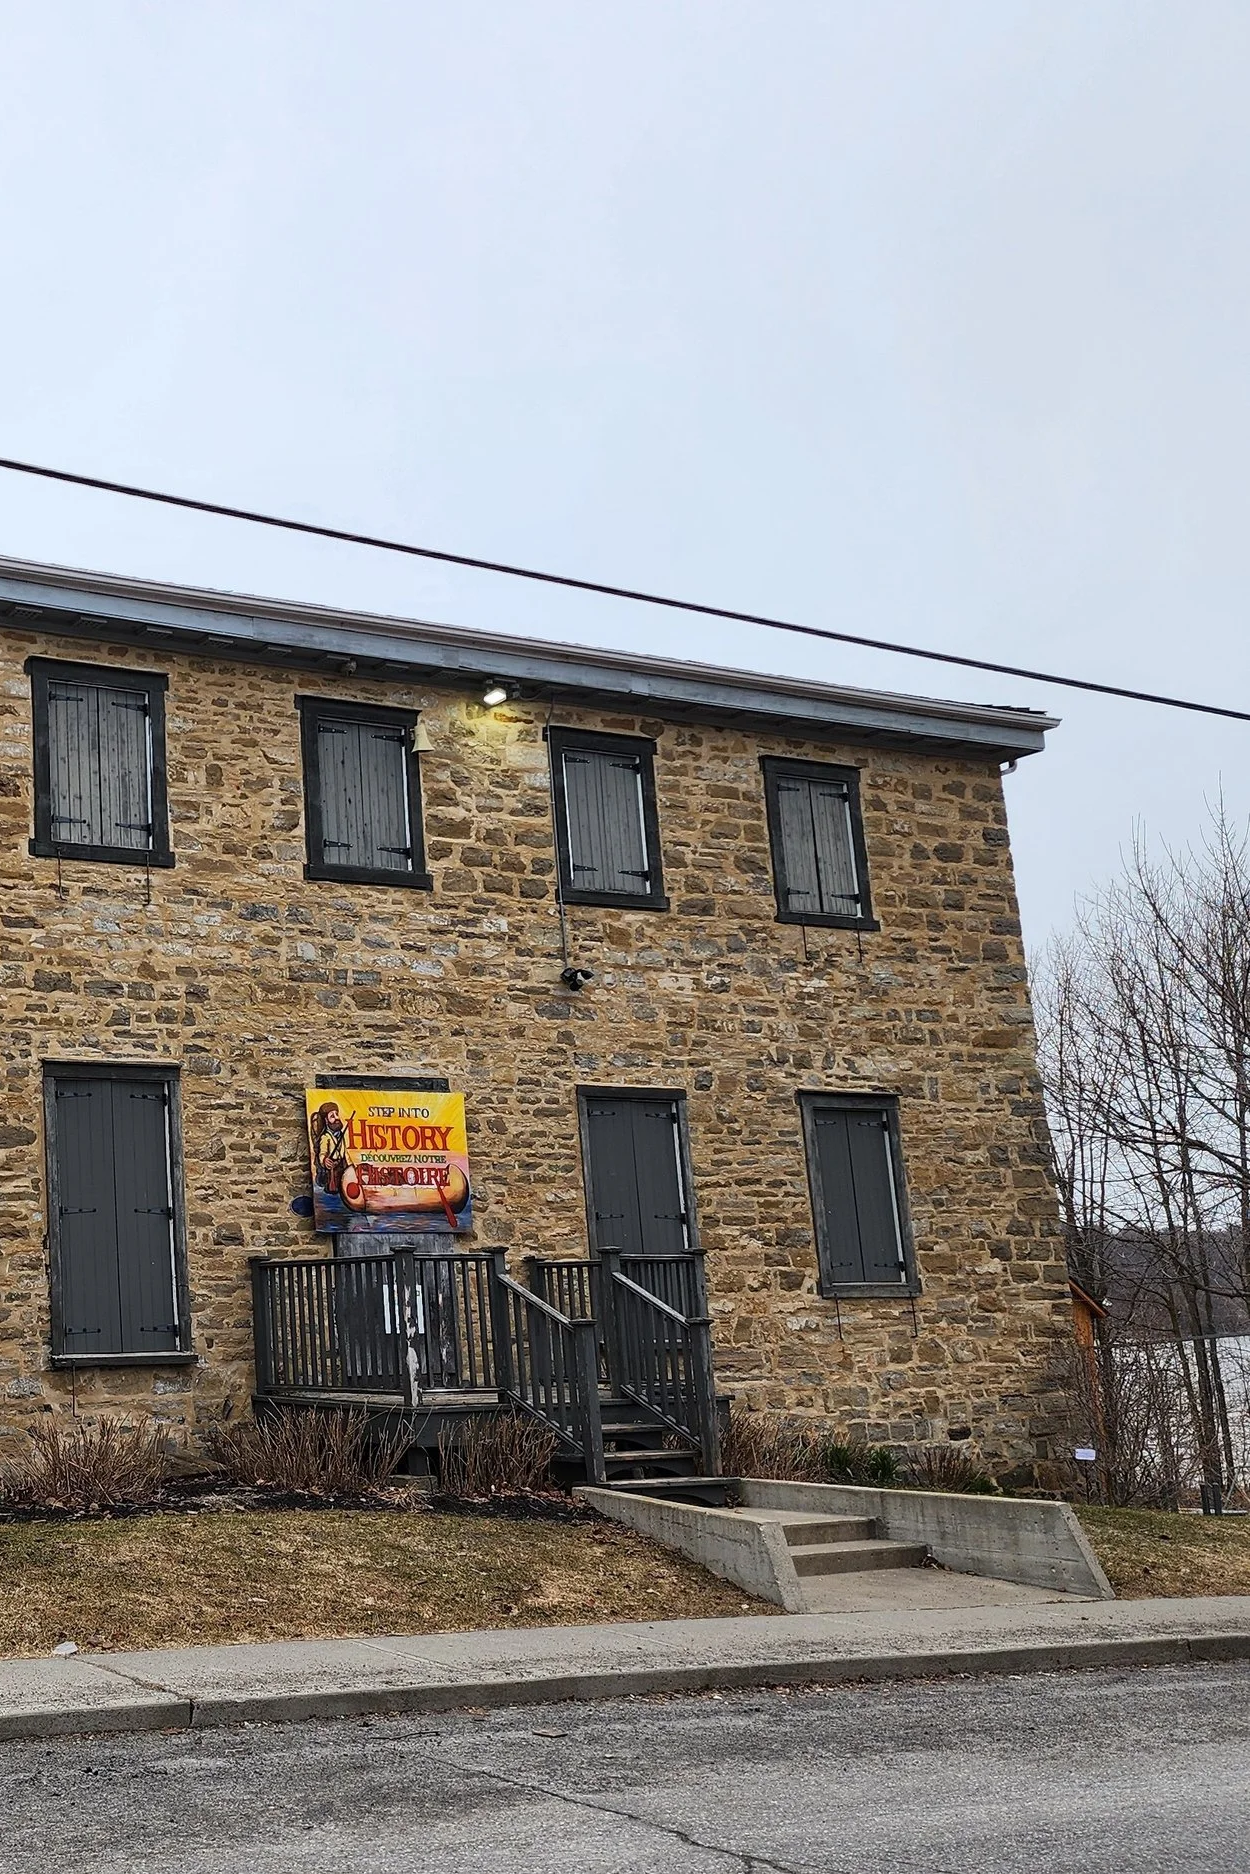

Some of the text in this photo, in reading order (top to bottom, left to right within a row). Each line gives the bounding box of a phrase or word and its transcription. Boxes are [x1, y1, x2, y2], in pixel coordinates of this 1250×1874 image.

[368, 1107, 429, 1118] STEP INTO
[345, 1119, 454, 1151] HISTORY
[361, 1152, 447, 1164] DÉCOUVREZ NOTRE
[355, 1163, 451, 1187] HISTOIRE
